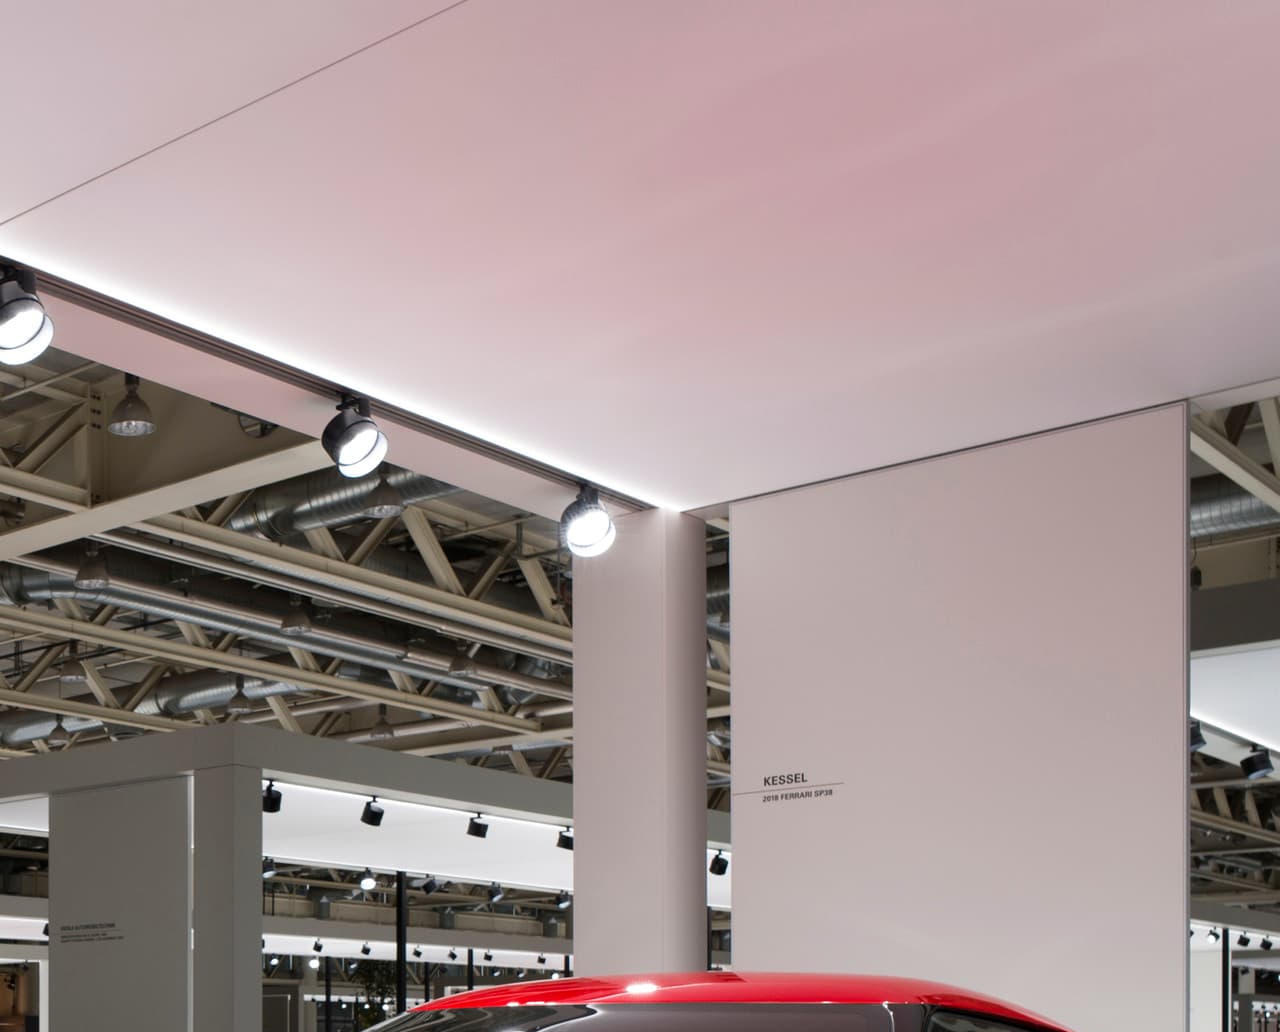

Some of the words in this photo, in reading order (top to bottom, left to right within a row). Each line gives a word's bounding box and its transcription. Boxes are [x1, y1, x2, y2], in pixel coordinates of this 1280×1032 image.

[763, 772, 808, 786] KESSEL
[762, 794, 779, 802] 2018
[781, 791, 813, 800] FERRARI
